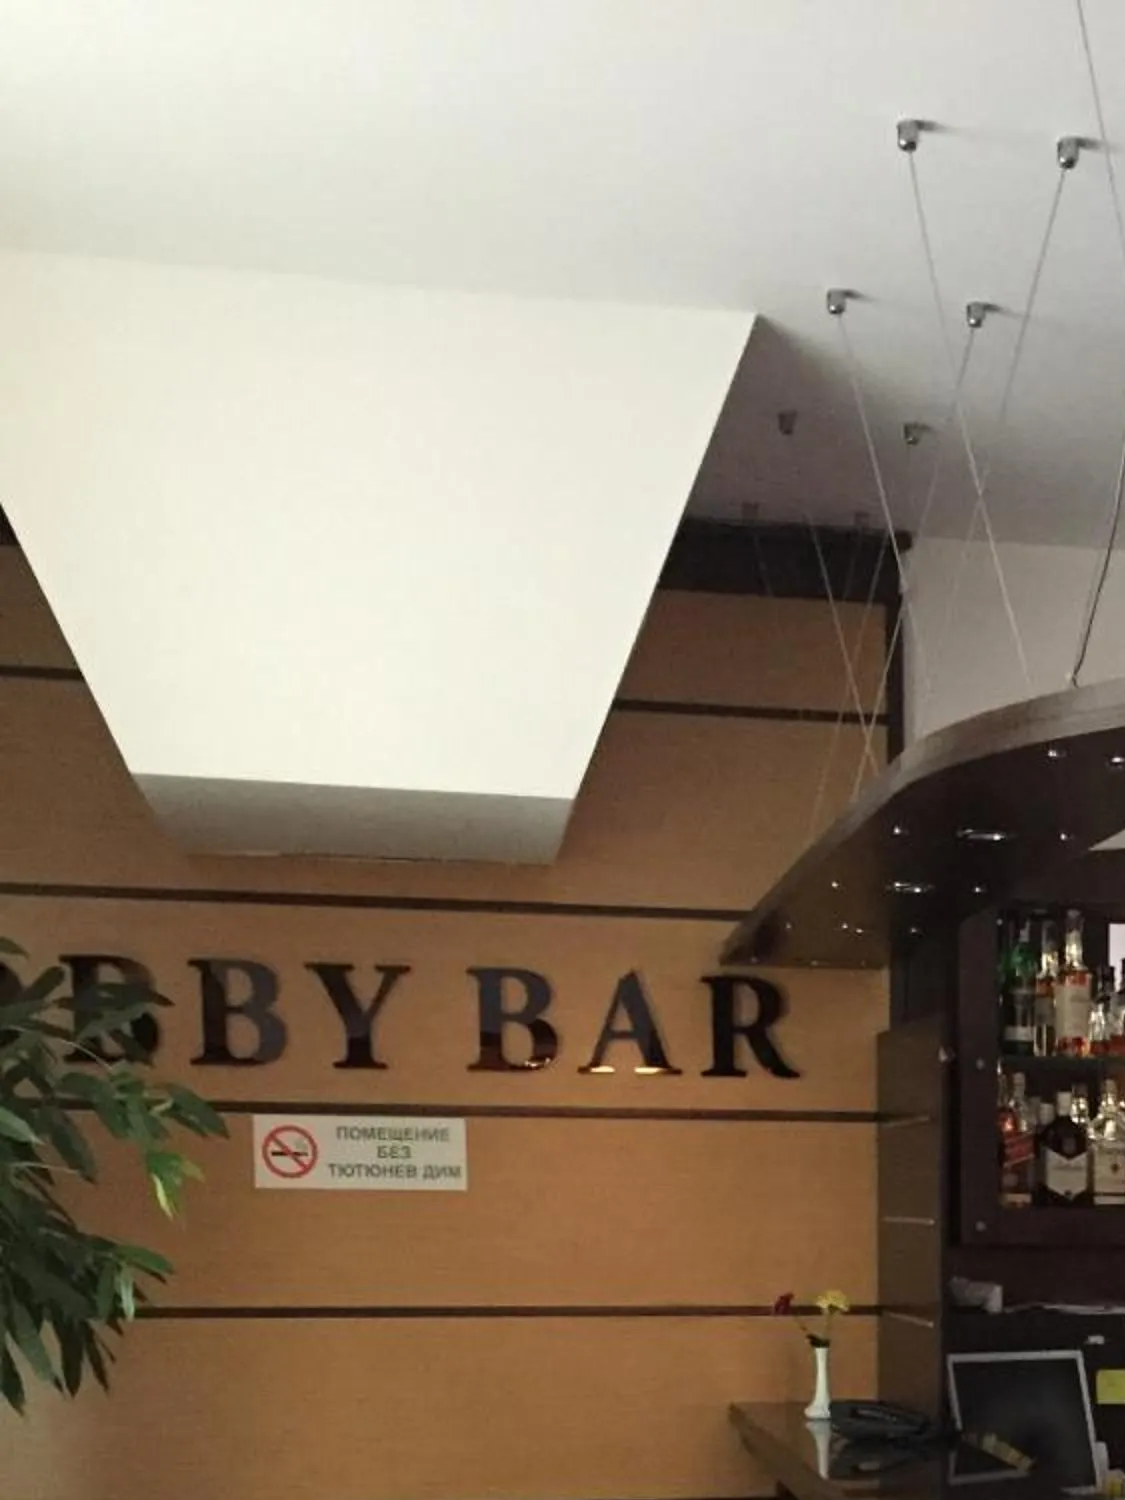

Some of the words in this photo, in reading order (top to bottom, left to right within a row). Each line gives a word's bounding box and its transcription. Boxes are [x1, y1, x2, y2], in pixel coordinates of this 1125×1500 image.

[466, 967, 802, 1078] BAR
[336, 1126, 449, 1142] ПОМЕЩЕНИЕ
[376, 1145, 412, 1159] БЕЗ
[328, 1163, 418, 1179] ТЮТЮНЕВ
[422, 1164, 462, 1180] ДИМ
